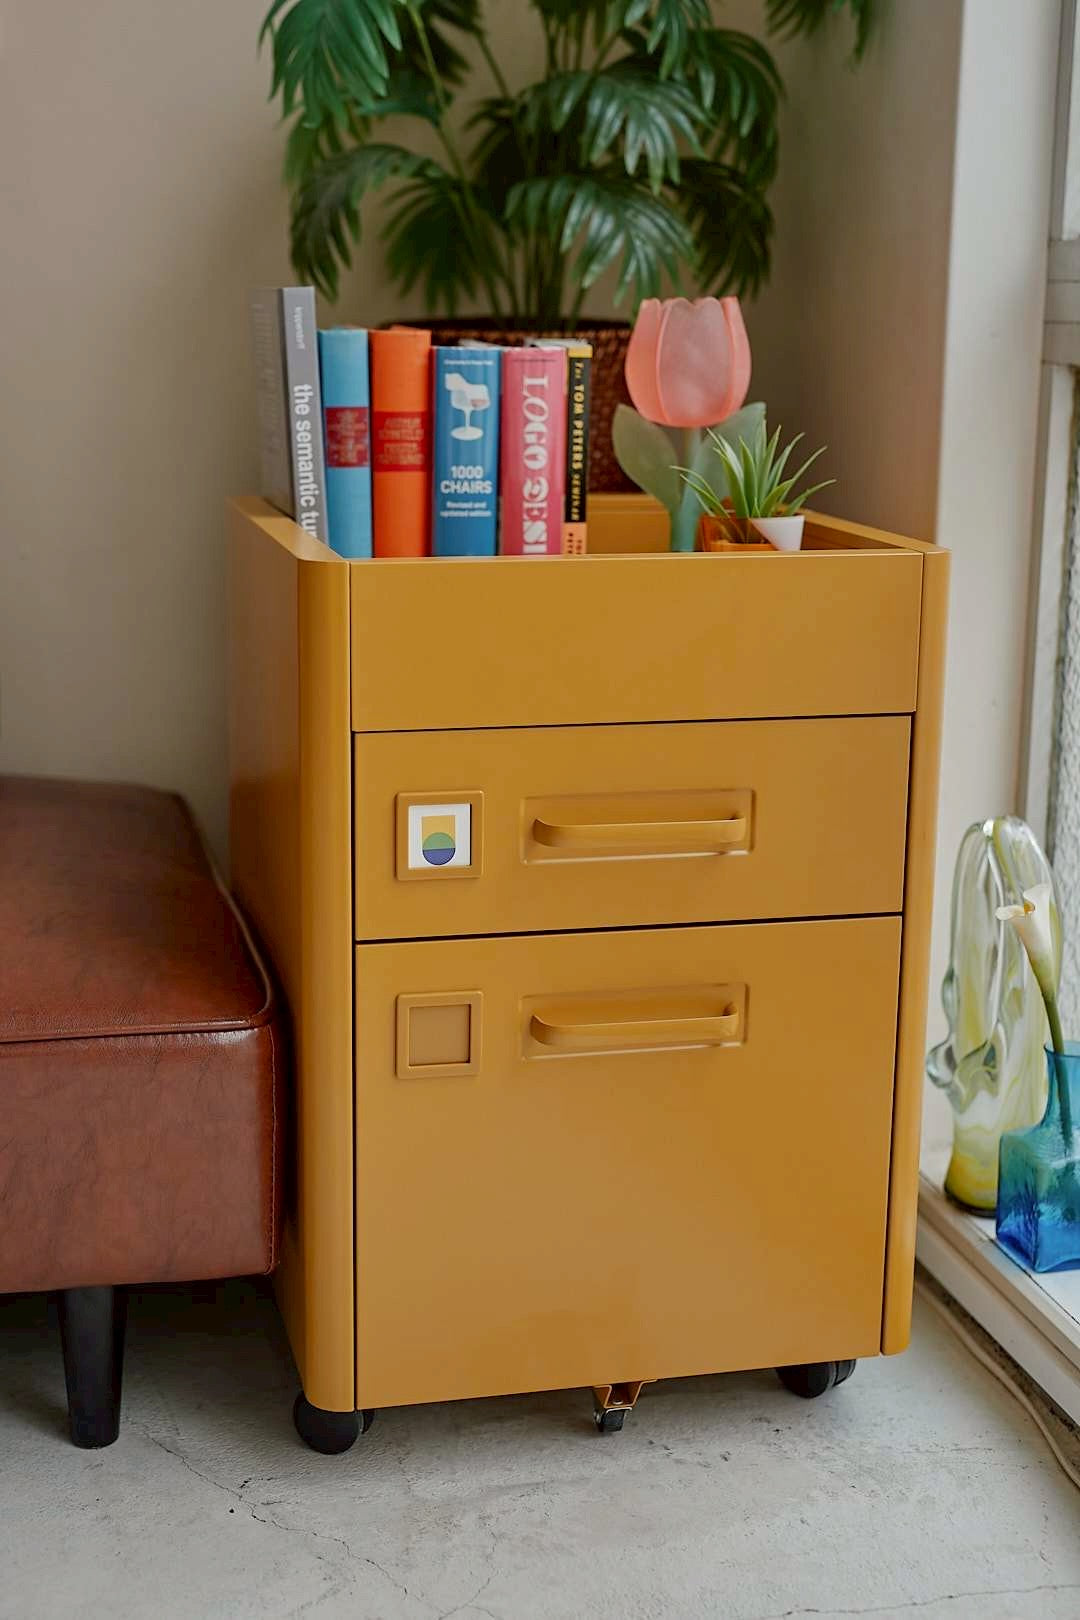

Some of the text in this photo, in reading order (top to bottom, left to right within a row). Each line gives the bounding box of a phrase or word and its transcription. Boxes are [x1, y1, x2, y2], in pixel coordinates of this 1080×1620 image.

[294, 384, 313, 414] the
[573, 384, 584, 414] TOM
[522, 376, 549, 470] LOGO
[572, 420, 584, 470] PETERS
[296, 420, 319, 506] semantic
[450, 466, 484, 480] 1000
[440, 480, 493, 494] CHAIRS
